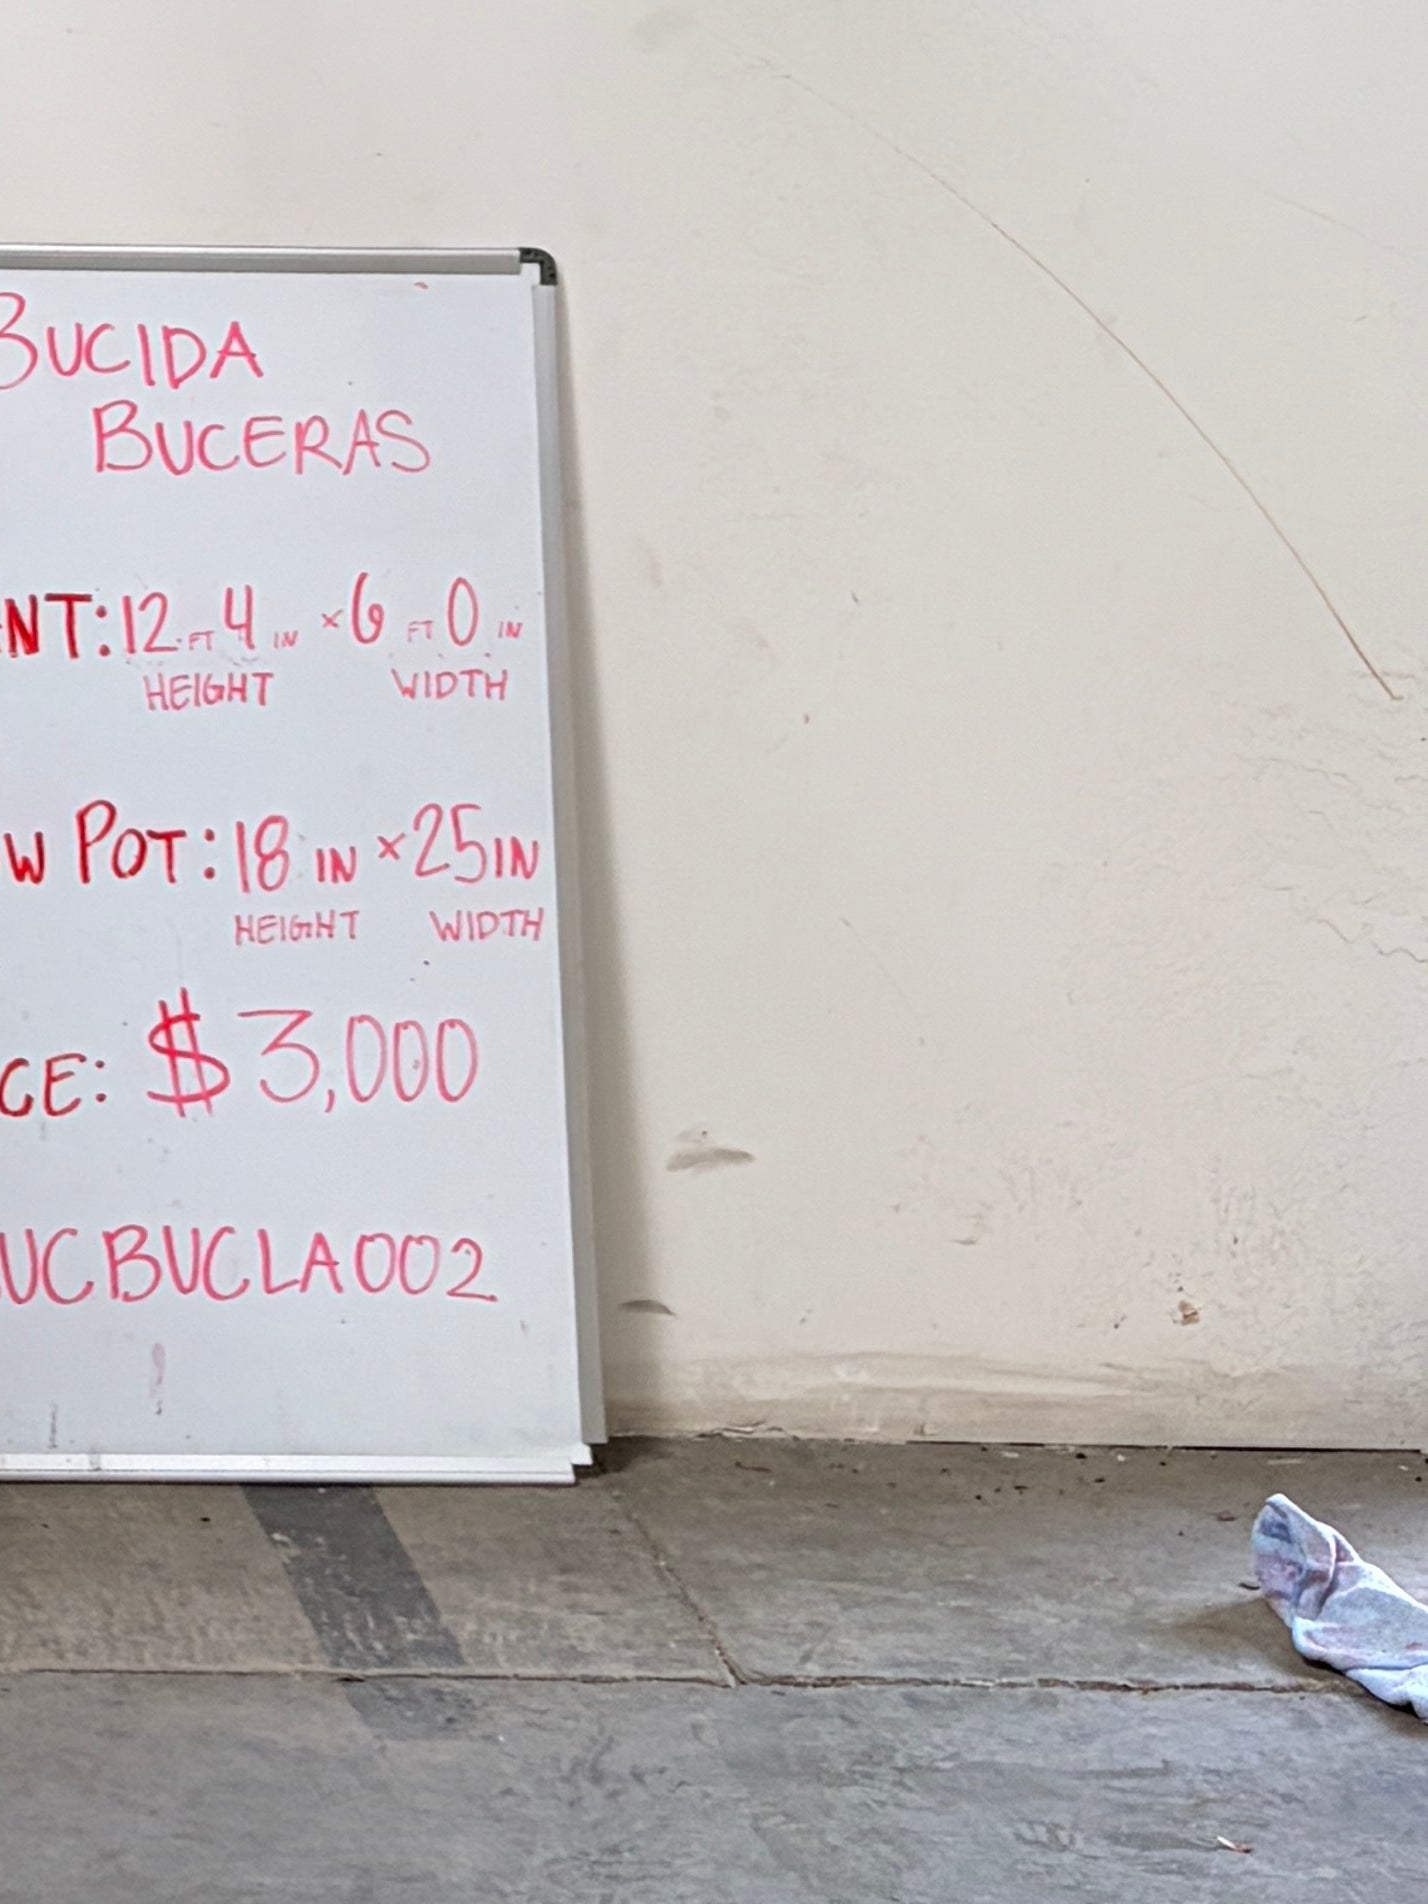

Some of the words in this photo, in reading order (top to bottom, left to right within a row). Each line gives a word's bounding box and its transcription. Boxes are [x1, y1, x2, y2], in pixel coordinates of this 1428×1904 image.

[92, 399, 431, 477] BUCERAS
[121, 591, 178, 656] 12
[188, 630, 215, 652] FT
[222, 585, 255, 651] 4
[273, 629, 299, 649] IN
[350, 571, 385, 646] 6
[407, 620, 434, 644] FT
[446, 577, 480, 648] 0
[497, 621, 523, 640] IN
[144, 671, 275, 712] HEIGHT
[390, 667, 509, 702] WIDTH
[74, 799, 218, 886] POT:
[234, 814, 292, 895] 18
[314, 843, 358, 886] IN
[234, 910, 361, 947] HEIGHT
[428, 907, 545, 943] WIDTH
